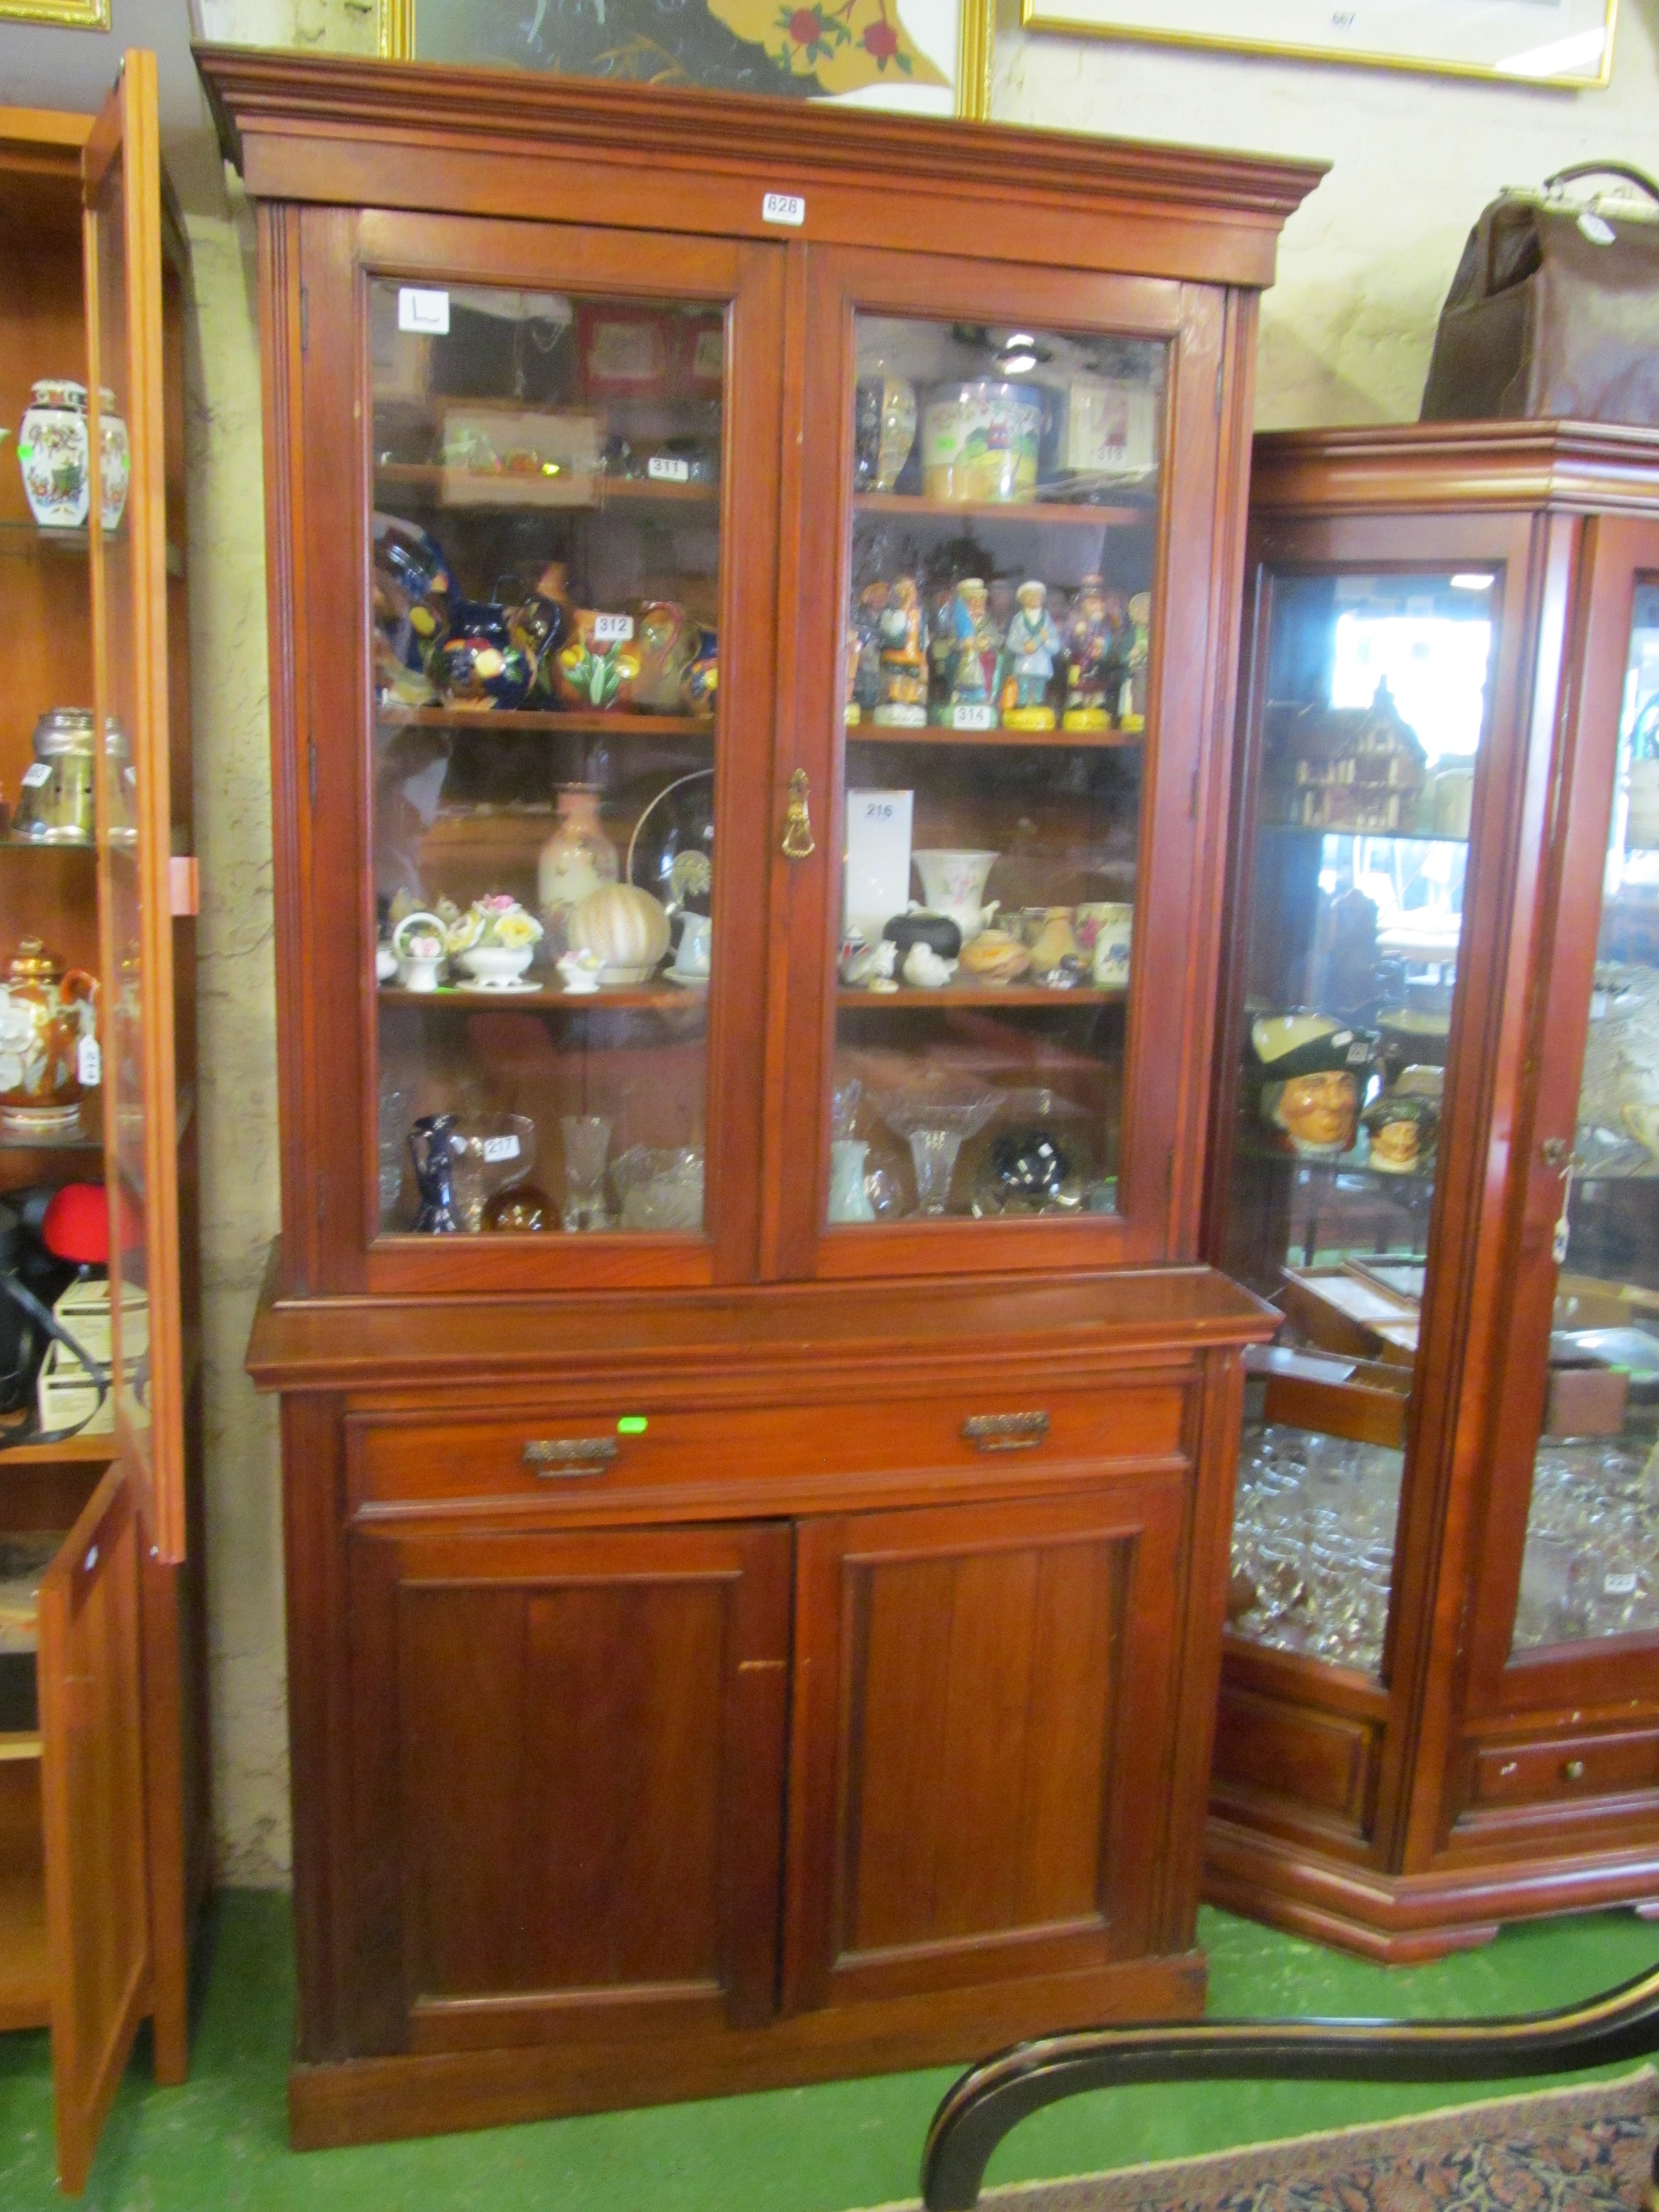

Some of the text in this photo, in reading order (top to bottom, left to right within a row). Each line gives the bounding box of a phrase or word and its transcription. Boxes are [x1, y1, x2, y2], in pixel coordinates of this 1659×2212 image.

[1332, 11, 1355, 25] 667
[768, 196, 798, 214] 828
[654, 459, 678, 472] 311
[600, 618, 627, 631] 312
[959, 707, 984, 721] 314
[867, 803, 894, 817] 216
[488, 1138, 513, 1153] 217
